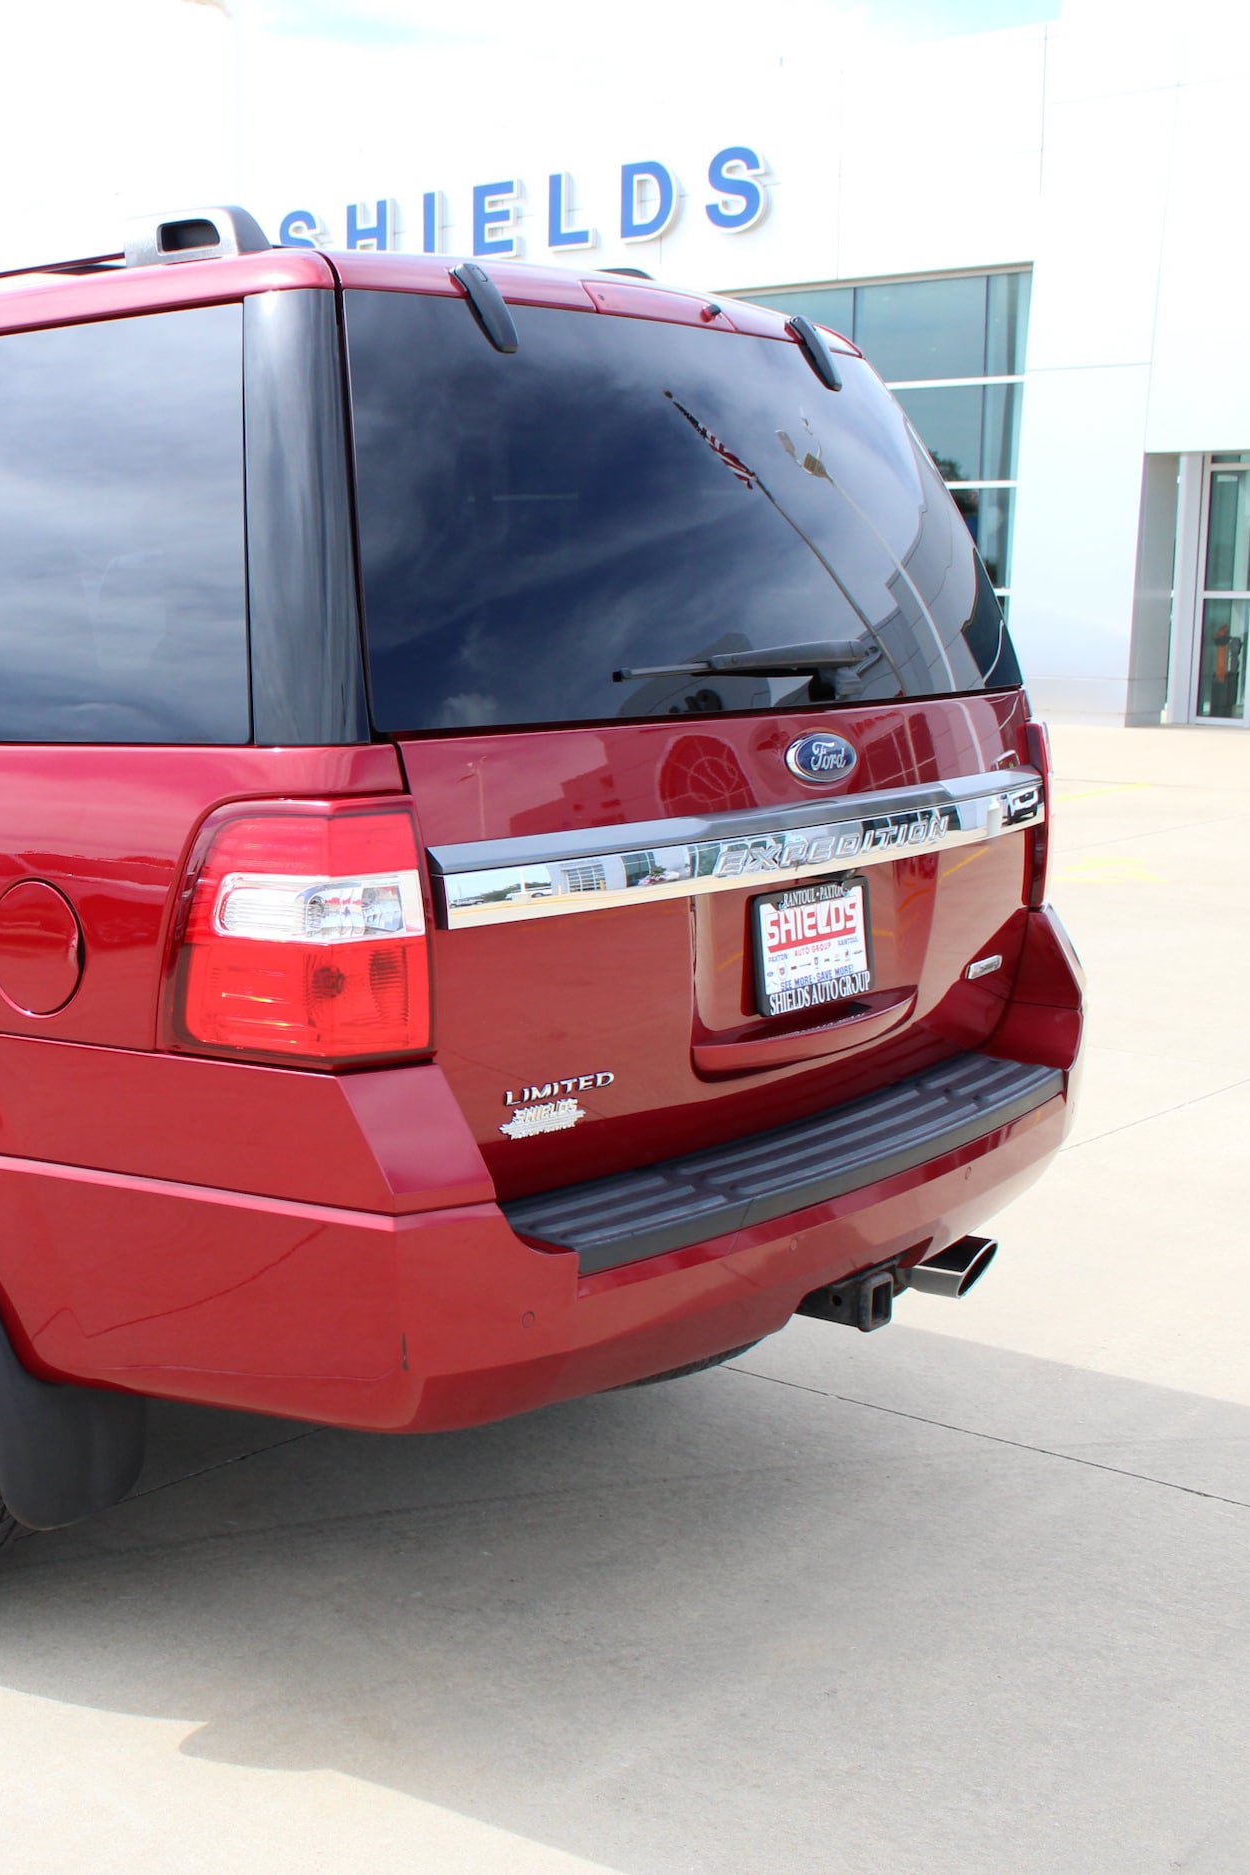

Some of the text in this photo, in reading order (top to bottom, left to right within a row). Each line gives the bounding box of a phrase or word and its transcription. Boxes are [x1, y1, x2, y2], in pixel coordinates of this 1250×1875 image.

[279, 146, 765, 257] SHIELDS
[810, 742, 847, 771] Ford
[713, 815, 949, 877] EXPEDITION
[783, 887, 816, 907] RANTOUL
[765, 896, 857, 946] SHIELDS
[794, 942, 832, 957] AUTO GROUP
[770, 971, 871, 1016] SHIELDS AUTO GROUP
[794, 975, 813, 988] MORE
[816, 971, 833, 982] SAVE
[505, 1072, 615, 1106] LIMITED
[514, 1098, 578, 1122] SHIELDS
